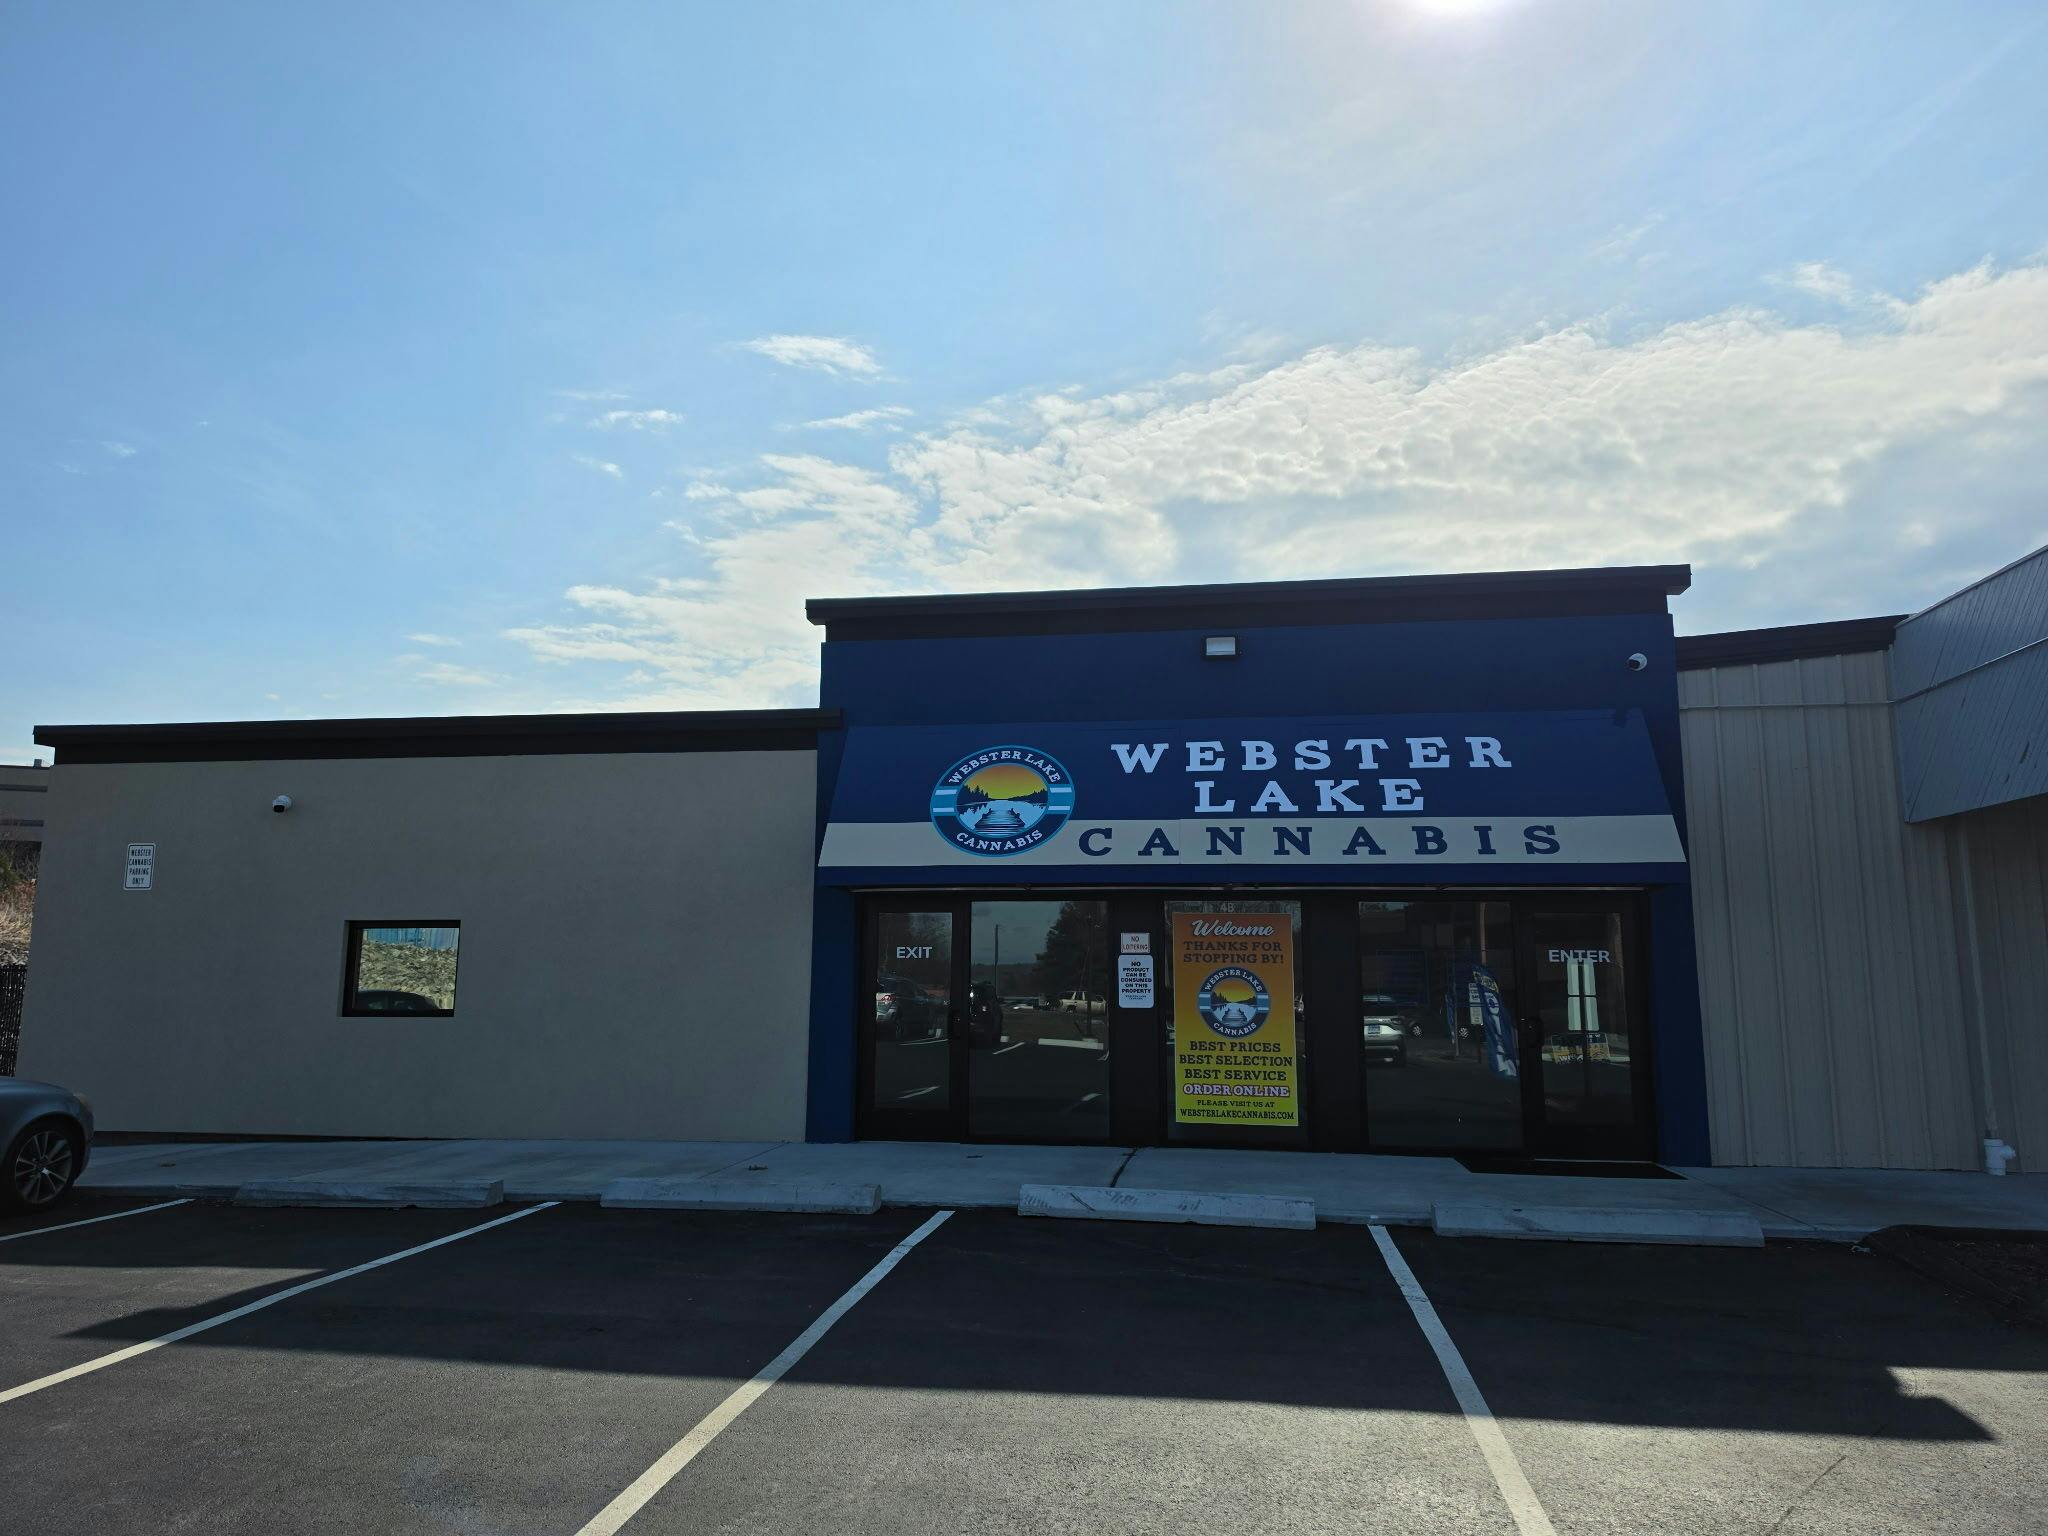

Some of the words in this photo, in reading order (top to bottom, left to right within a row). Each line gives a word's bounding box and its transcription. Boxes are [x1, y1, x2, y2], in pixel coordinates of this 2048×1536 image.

[1110, 736, 1513, 774] WEBSTER
[948, 750, 1022, 784] WEBSTER
[1024, 752, 1061, 783] LAKE
[1194, 778, 1424, 813] LAKE
[956, 829, 1043, 851] CANNABIS
[1078, 825, 1561, 857] CANNABIS
[1191, 919, 1275, 937] Welcome
[896, 946, 933, 959] EXIT
[1183, 940, 1249, 951] THANKS
[1251, 941, 1283, 952] FOR
[1183, 953, 1258, 964] STOPPING
[1261, 954, 1285, 965] BY!
[1548, 949, 1611, 963] ENTER
[1204, 968, 1242, 992] WEBSTER
[1242, 970, 1264, 992] LAKE
[1213, 1022, 1257, 1036] CANNABIS
[1189, 1040, 1226, 1052] BEST
[1229, 1041, 1281, 1053] PRICES
[1179, 1054, 1213, 1065] BEST
[1215, 1055, 1293, 1067] SELECTION
[1184, 1068, 1221, 1080] BEST
[1224, 1069, 1287, 1081] SERVICE
[1183, 1083, 1232, 1096] ORDER
[1232, 1084, 1290, 1097] ONLINE
[1197, 1099, 1229, 1107] PLEASE
[1230, 1100, 1252, 1108] VISIT
[1265, 1101, 1275, 1109] AT
[1179, 1107, 1295, 1120] WEBSTERLAKECANNABIS.COM
